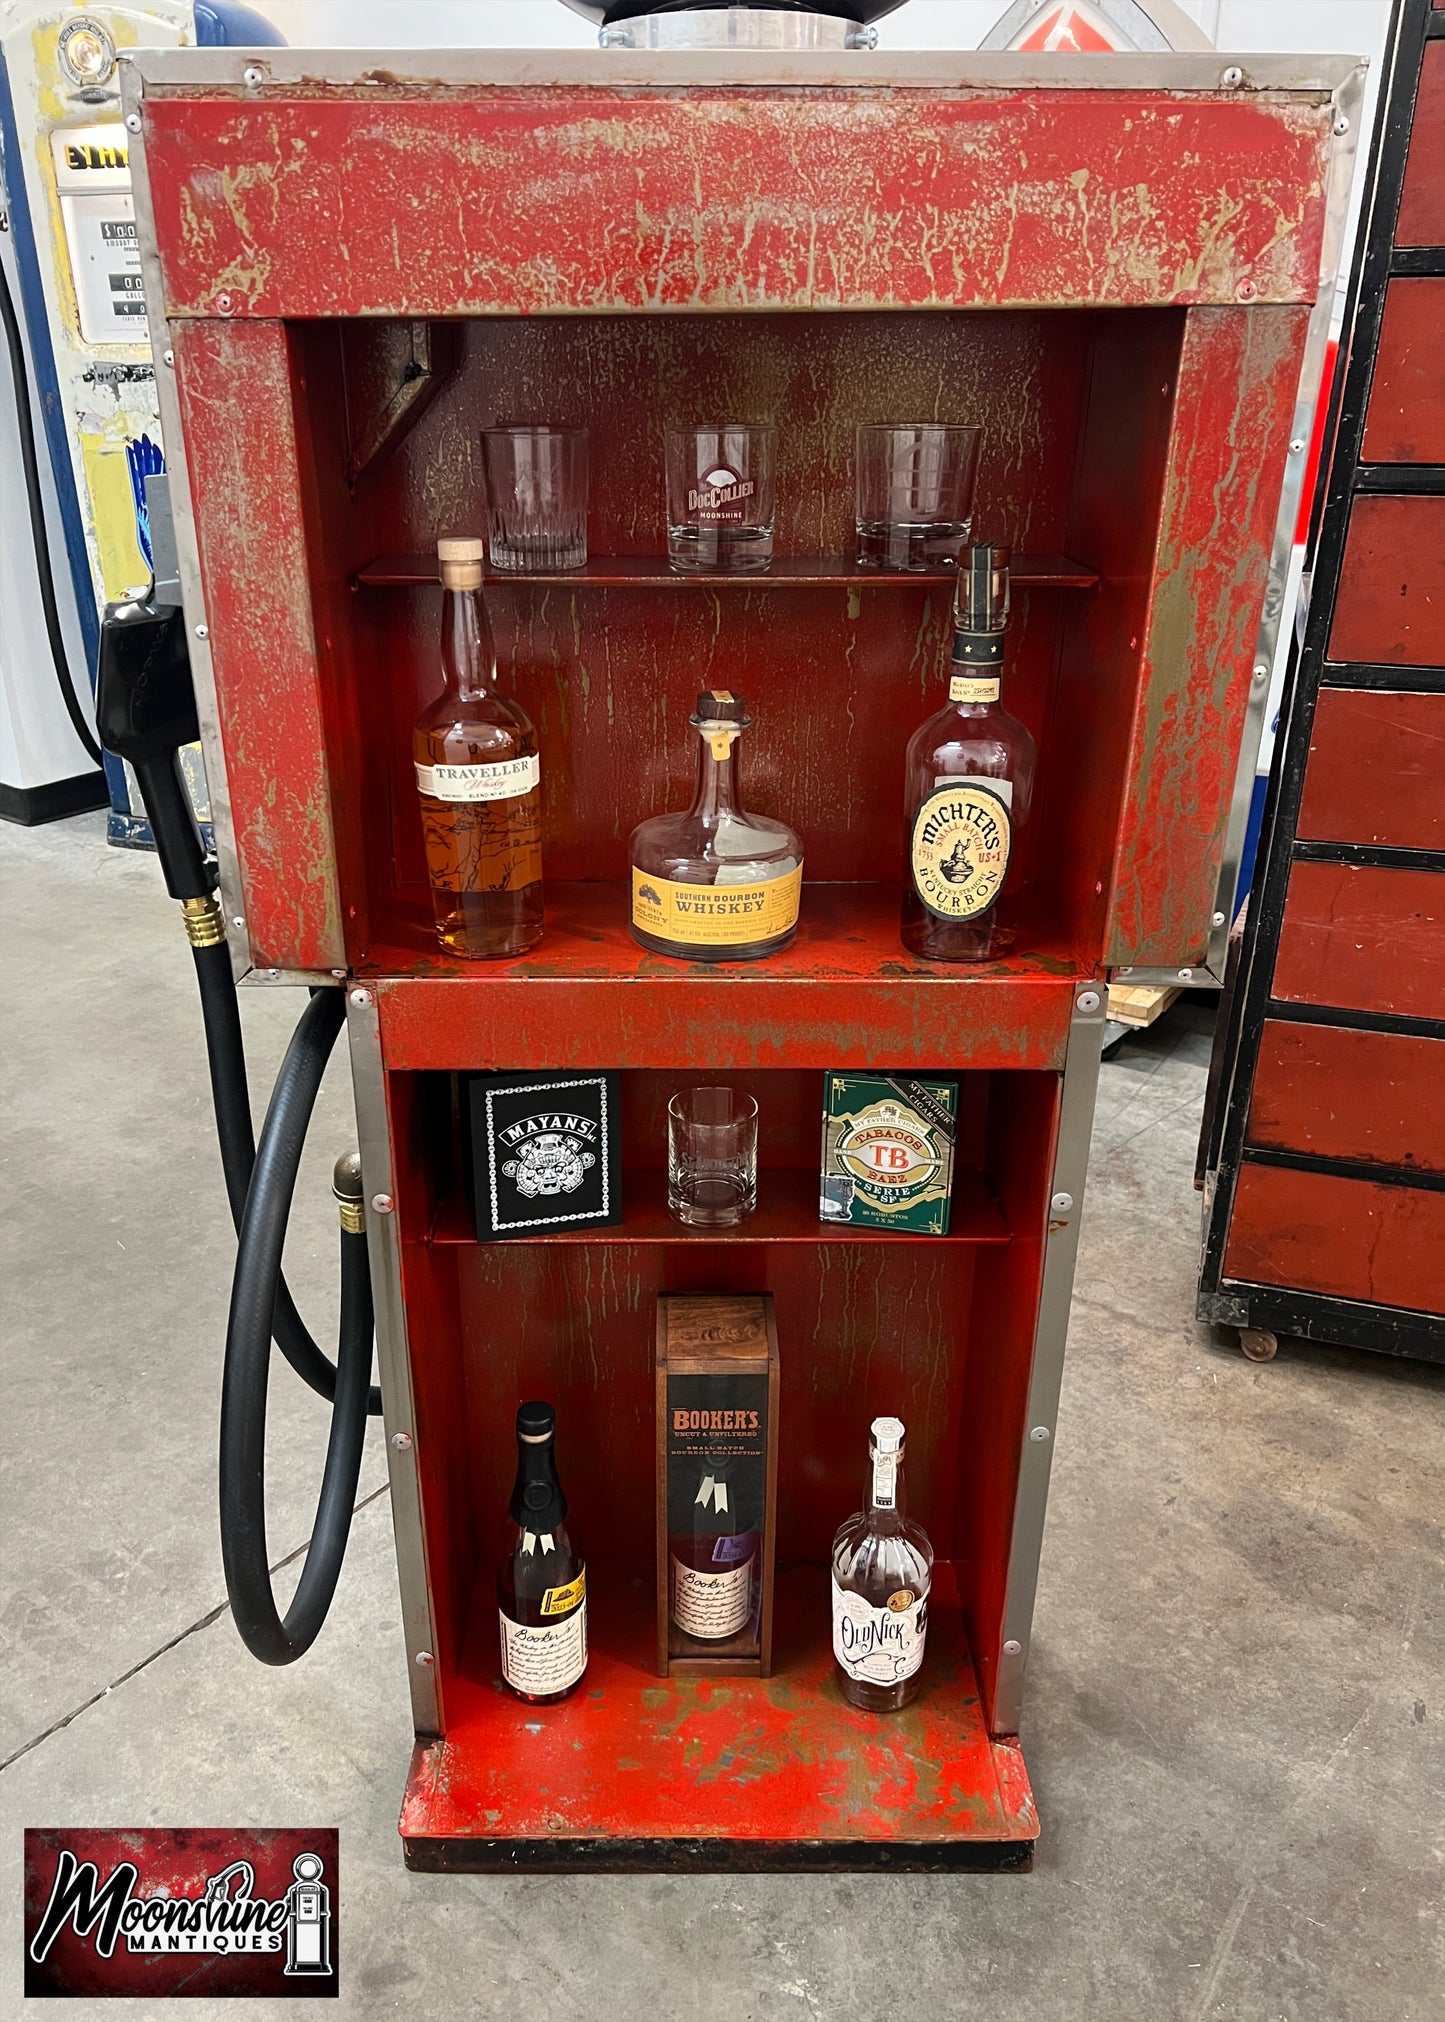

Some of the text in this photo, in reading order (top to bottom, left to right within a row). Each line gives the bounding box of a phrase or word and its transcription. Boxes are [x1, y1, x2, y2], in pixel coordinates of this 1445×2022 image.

[436, 760, 529, 779] TRAVELLER
[935, 822, 960, 847] SMALL
[962, 822, 984, 851] BATCH
[675, 892, 711, 901] SOUTHERN
[714, 891, 765, 902] BOURBON
[919, 867, 998, 907] BOURBON
[676, 900, 765, 915] WHISKEY
[908, 1082, 922, 1097] MY
[921, 1094, 952, 1125] FATHER
[908, 1094, 939, 1124] CIGARS
[507, 1116, 591, 1141] MAYANS
[854, 1119, 865, 1128] MY
[867, 1116, 896, 1124] FATHER
[855, 1129, 923, 1150] TABACOS
[869, 1144, 909, 1169] TB
[925, 1158, 945, 1166] MADE
[867, 1169, 908, 1183] BAEZ
[864, 1182, 911, 1196] SERIE
[880, 1194, 898, 1204] SF
[673, 1410, 759, 1430] BOOKER'S
[683, 1571, 743, 1589] Booker's
[514, 1620, 575, 1643] Booker's
